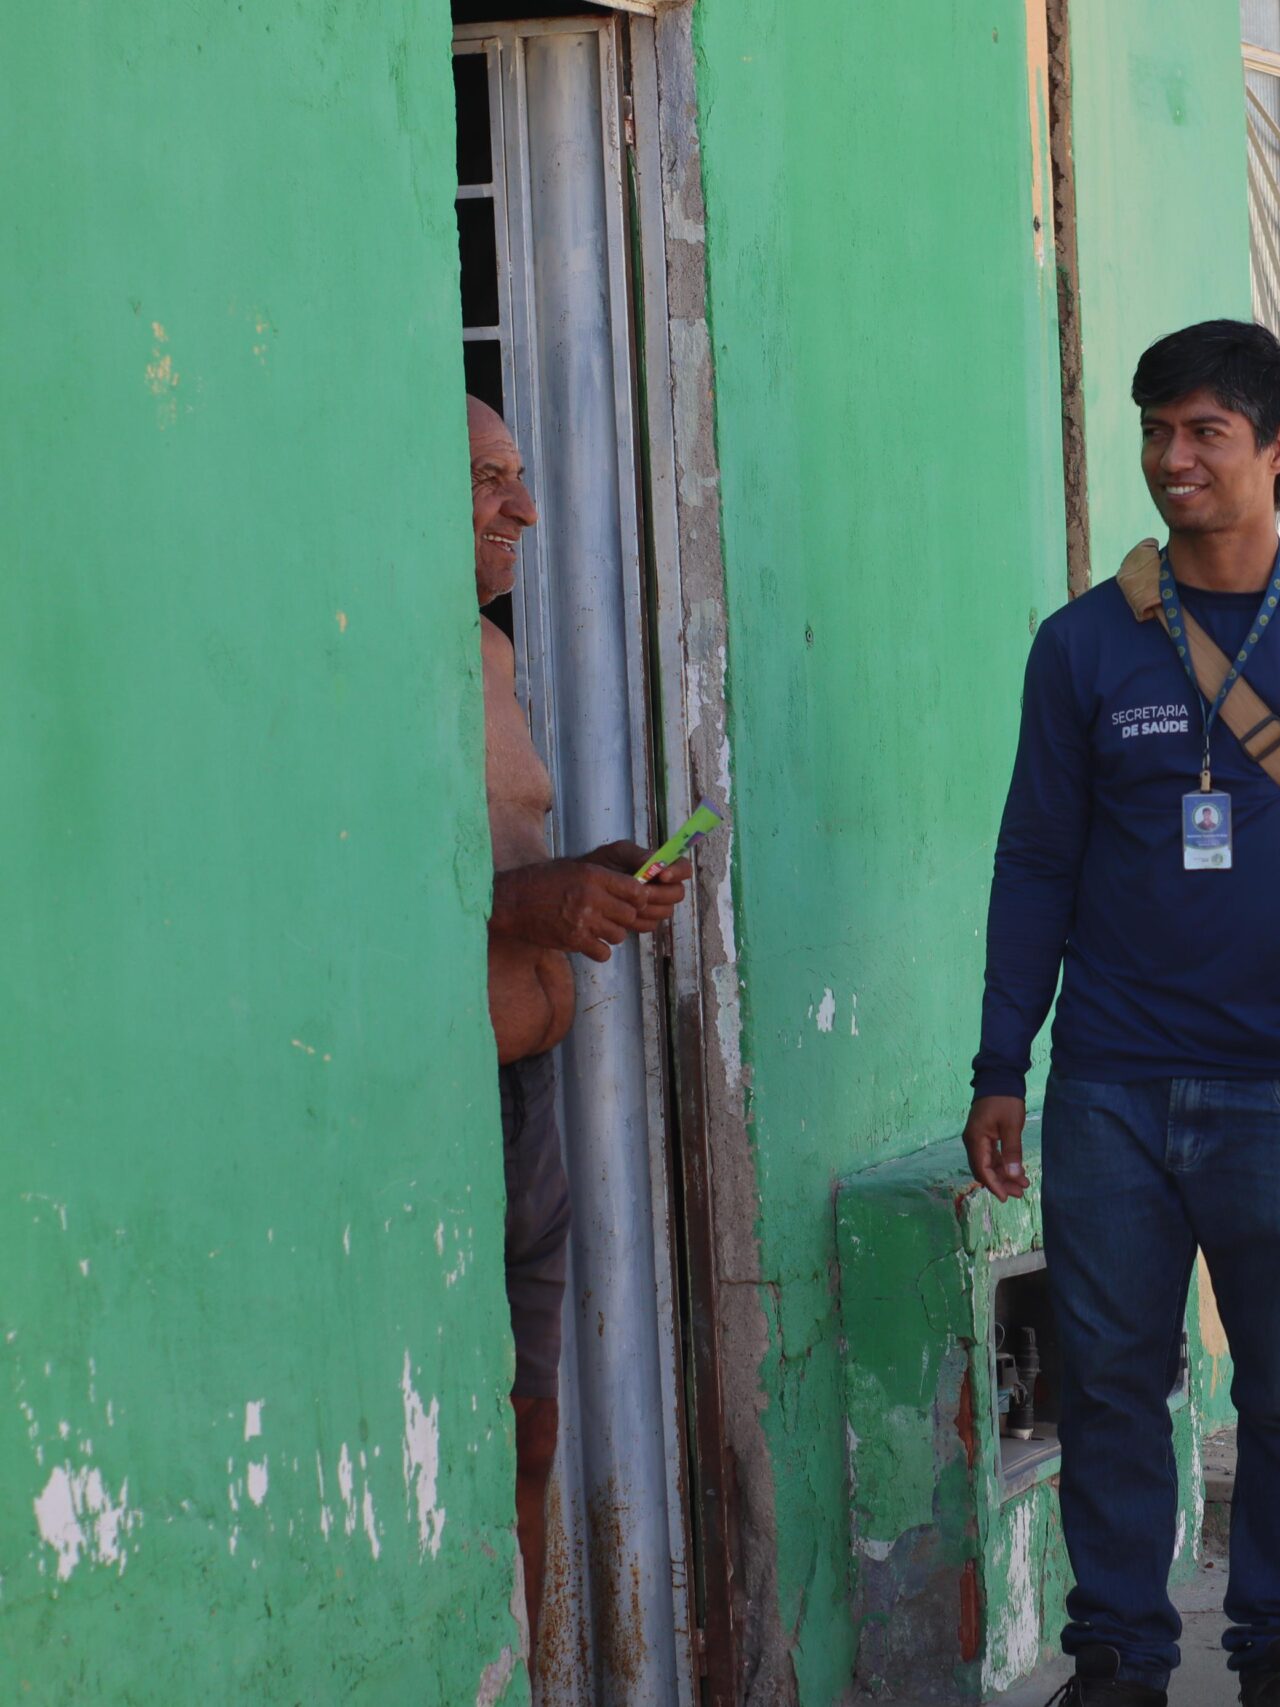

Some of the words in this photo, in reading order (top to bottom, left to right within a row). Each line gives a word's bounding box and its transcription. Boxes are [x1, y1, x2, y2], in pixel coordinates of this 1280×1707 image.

[1112, 704, 1188, 725] SECRETARIA
[1122, 724, 1140, 739] DE
[1142, 718, 1188, 736] SAÚDE
